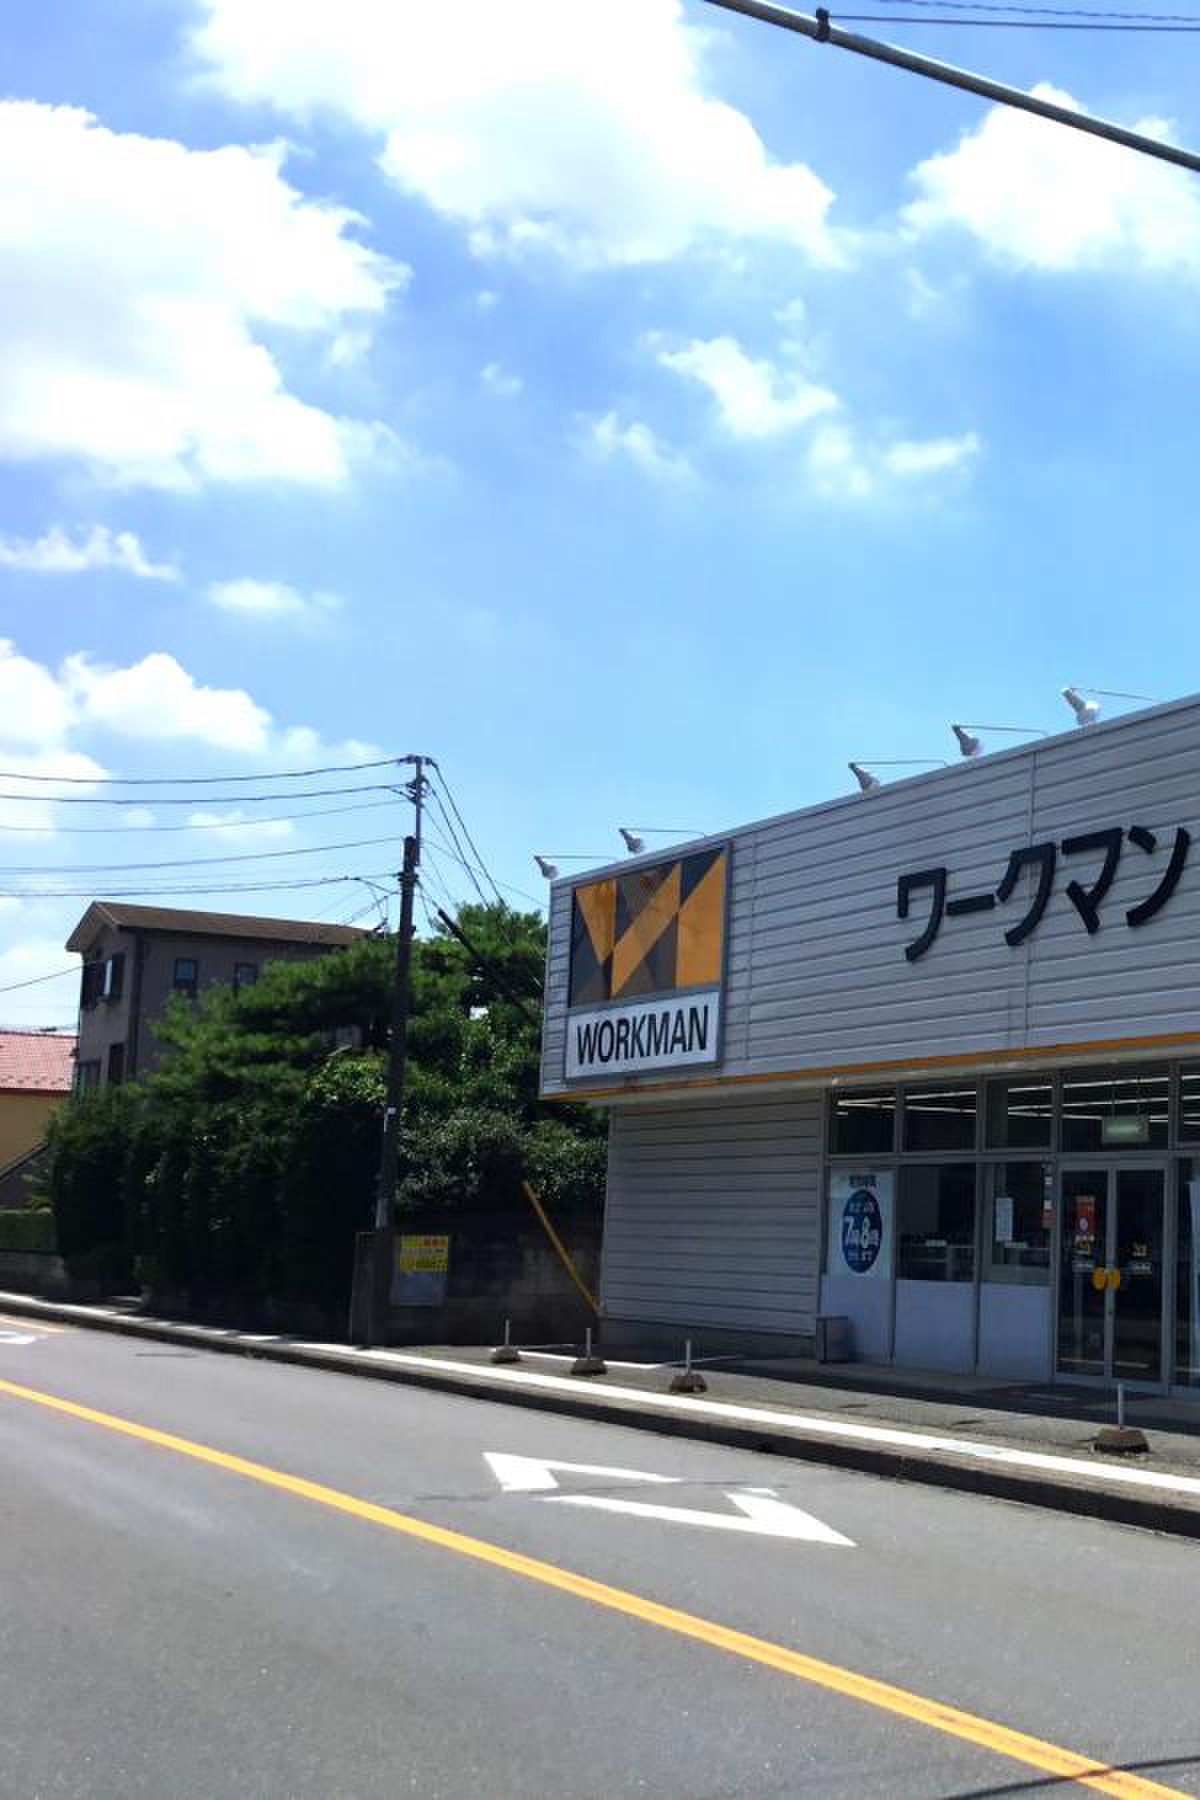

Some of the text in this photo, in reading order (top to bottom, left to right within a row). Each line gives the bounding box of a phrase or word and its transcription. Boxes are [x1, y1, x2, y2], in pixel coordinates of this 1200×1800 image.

[896, 825, 1190, 963] ワークマン
[577, 1004, 709, 1065] WORKMAN
